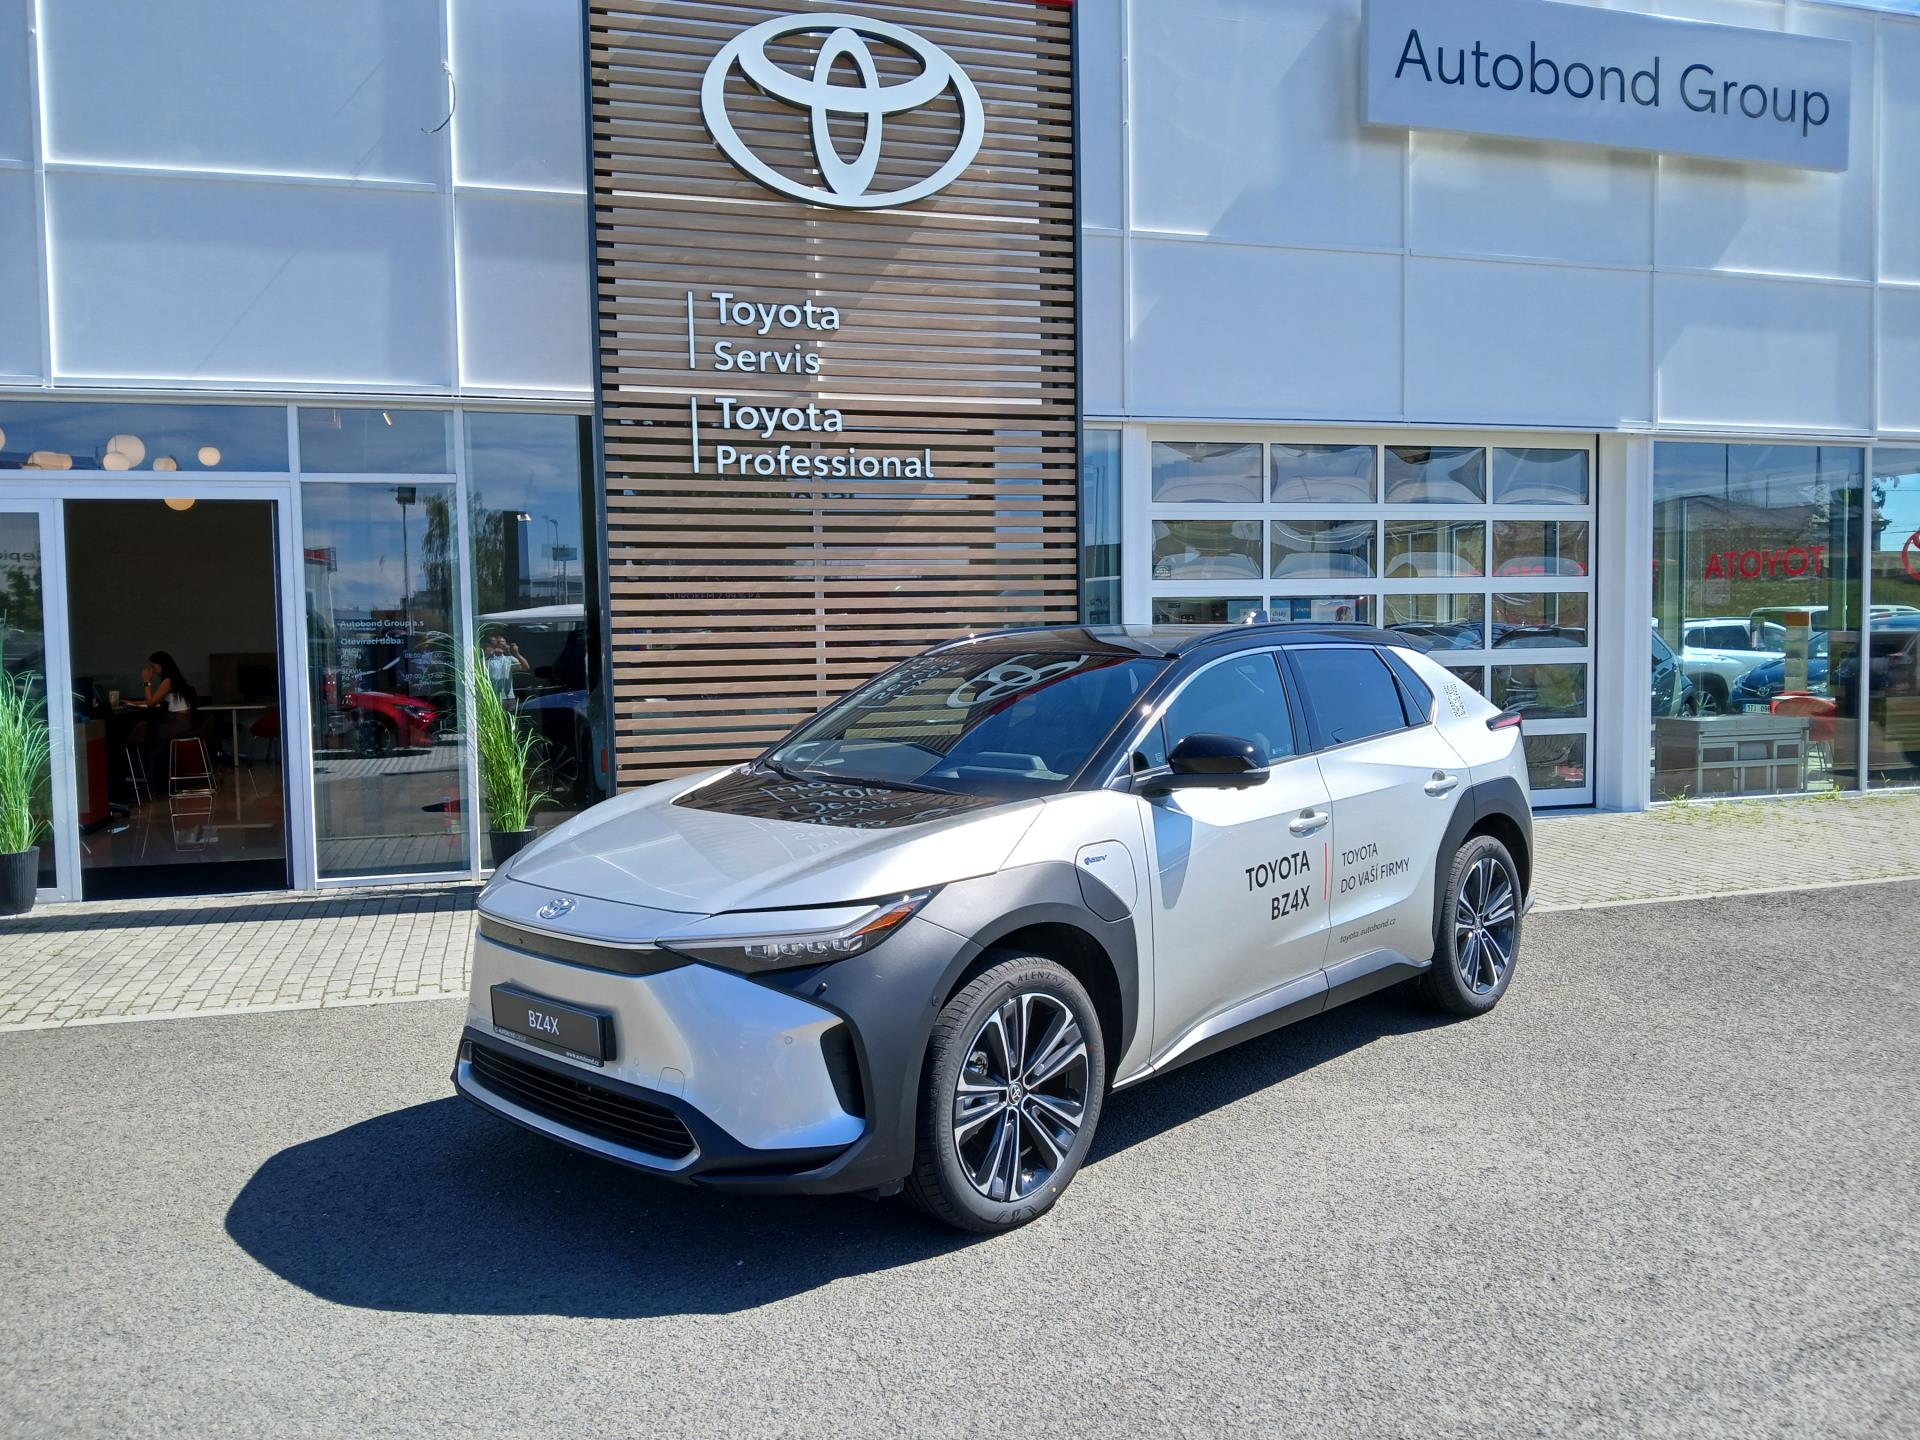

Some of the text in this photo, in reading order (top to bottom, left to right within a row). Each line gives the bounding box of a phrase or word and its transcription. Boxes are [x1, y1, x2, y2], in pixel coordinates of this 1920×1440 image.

[1394, 28, 1830, 137] Autobond Group
[711, 292, 840, 335] Toyota
[714, 341, 820, 374] Servis
[715, 397, 843, 439] Toyota
[717, 445, 934, 478] Professional
[340, 620, 383, 628] Autobond
[384, 619, 411, 628] Group
[1245, 850, 1311, 891] TOYOTA
[1341, 842, 1378, 867] TOYOTA
[1340, 857, 1410, 893] DO VAŠÍ FIRMY
[1271, 885, 1311, 921] BZ4X
[528, 1010, 560, 1035] BZ4X
